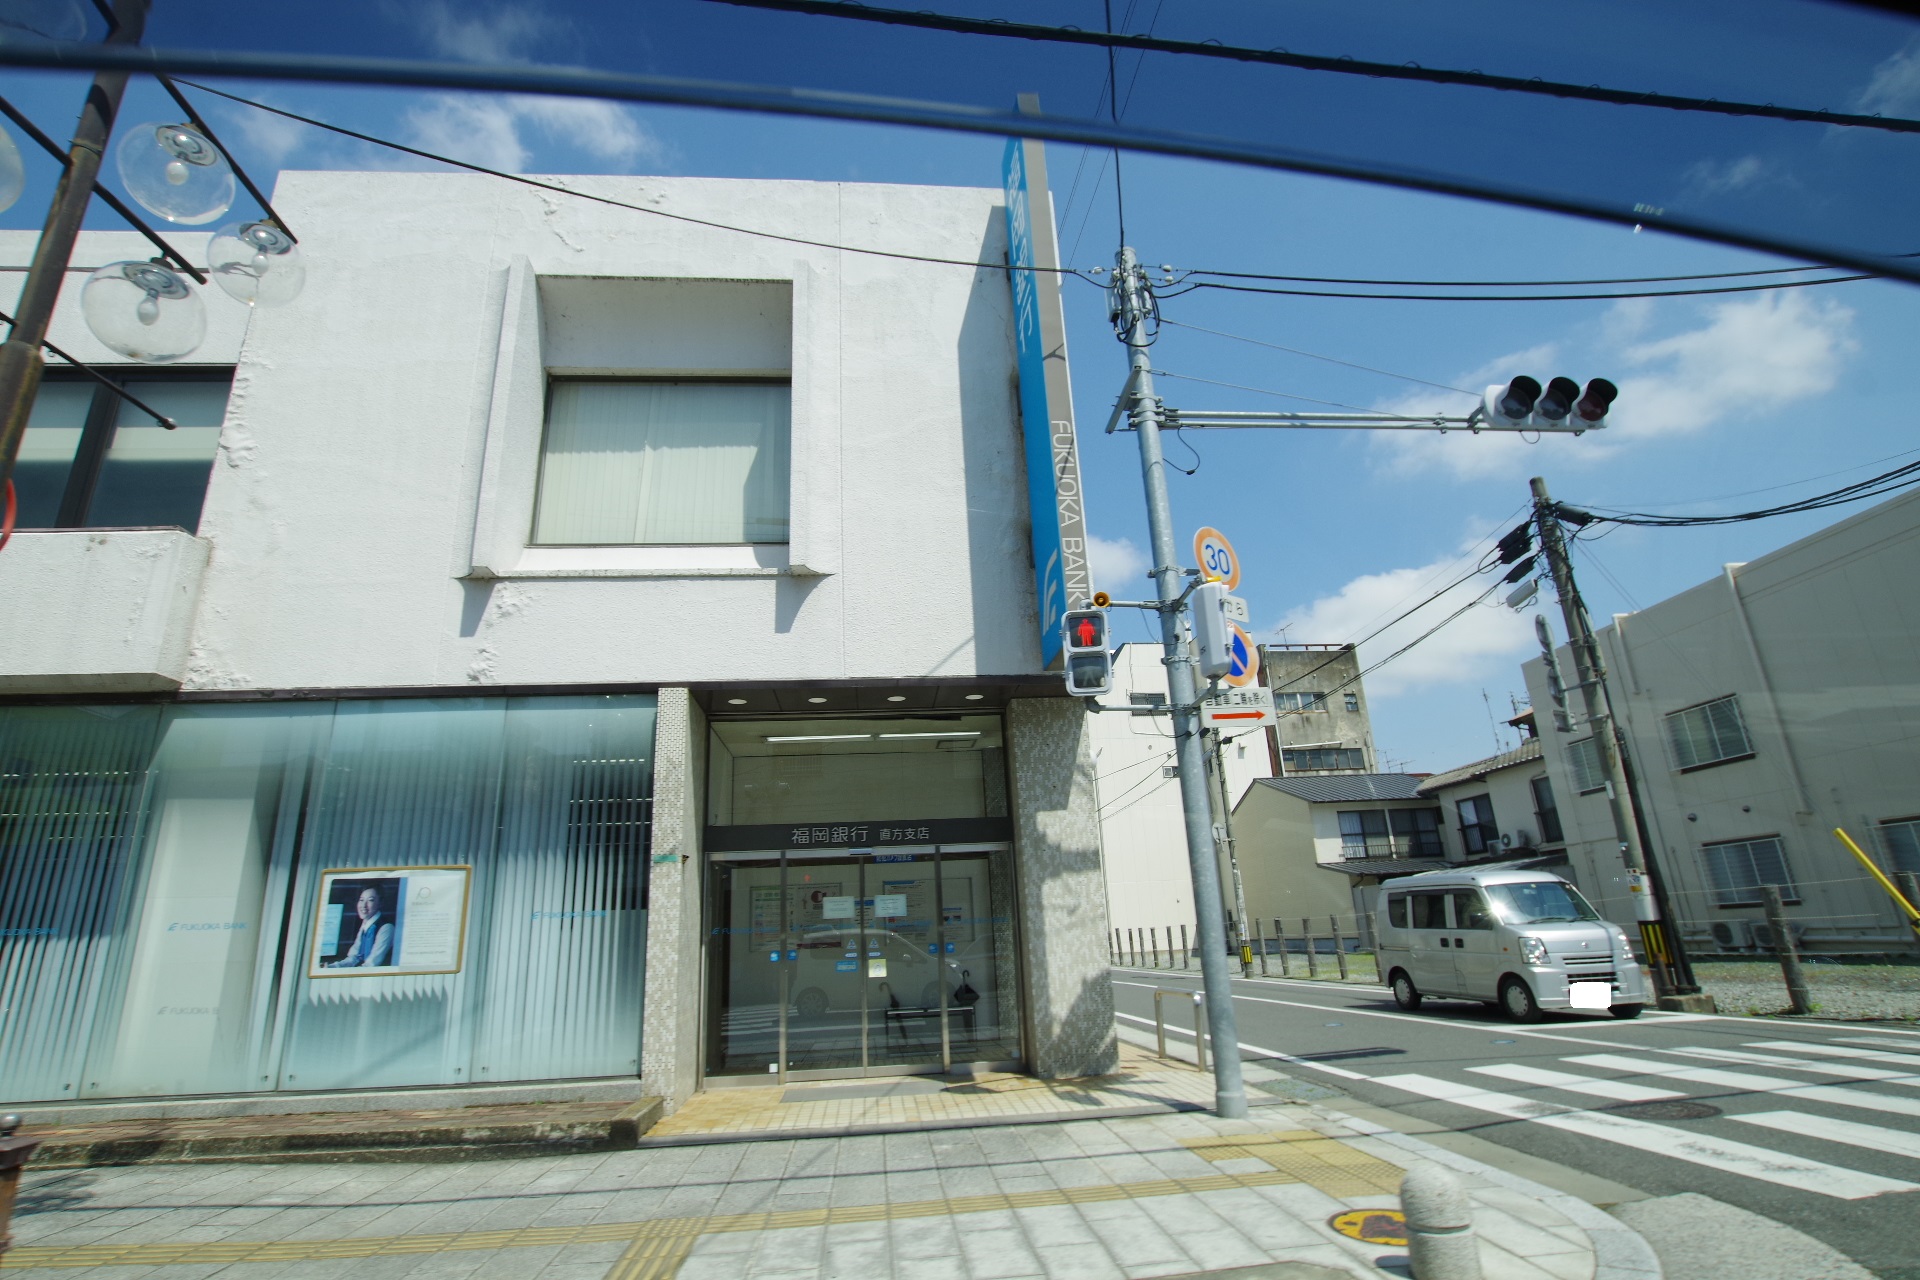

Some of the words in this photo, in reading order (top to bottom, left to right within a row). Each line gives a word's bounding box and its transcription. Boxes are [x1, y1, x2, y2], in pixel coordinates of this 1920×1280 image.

[1008, 142, 1033, 354] 福岡銀行
[1051, 420, 1081, 527] FUKUOKA
[1061, 537, 1088, 604] BANK
[1205, 544, 1230, 575] 30
[791, 826, 869, 843] 福岡銀行
[879, 827, 930, 841] 直方支店
[181, 922, 221, 931] FUKUOKA
[223, 922, 247, 930] BANK
